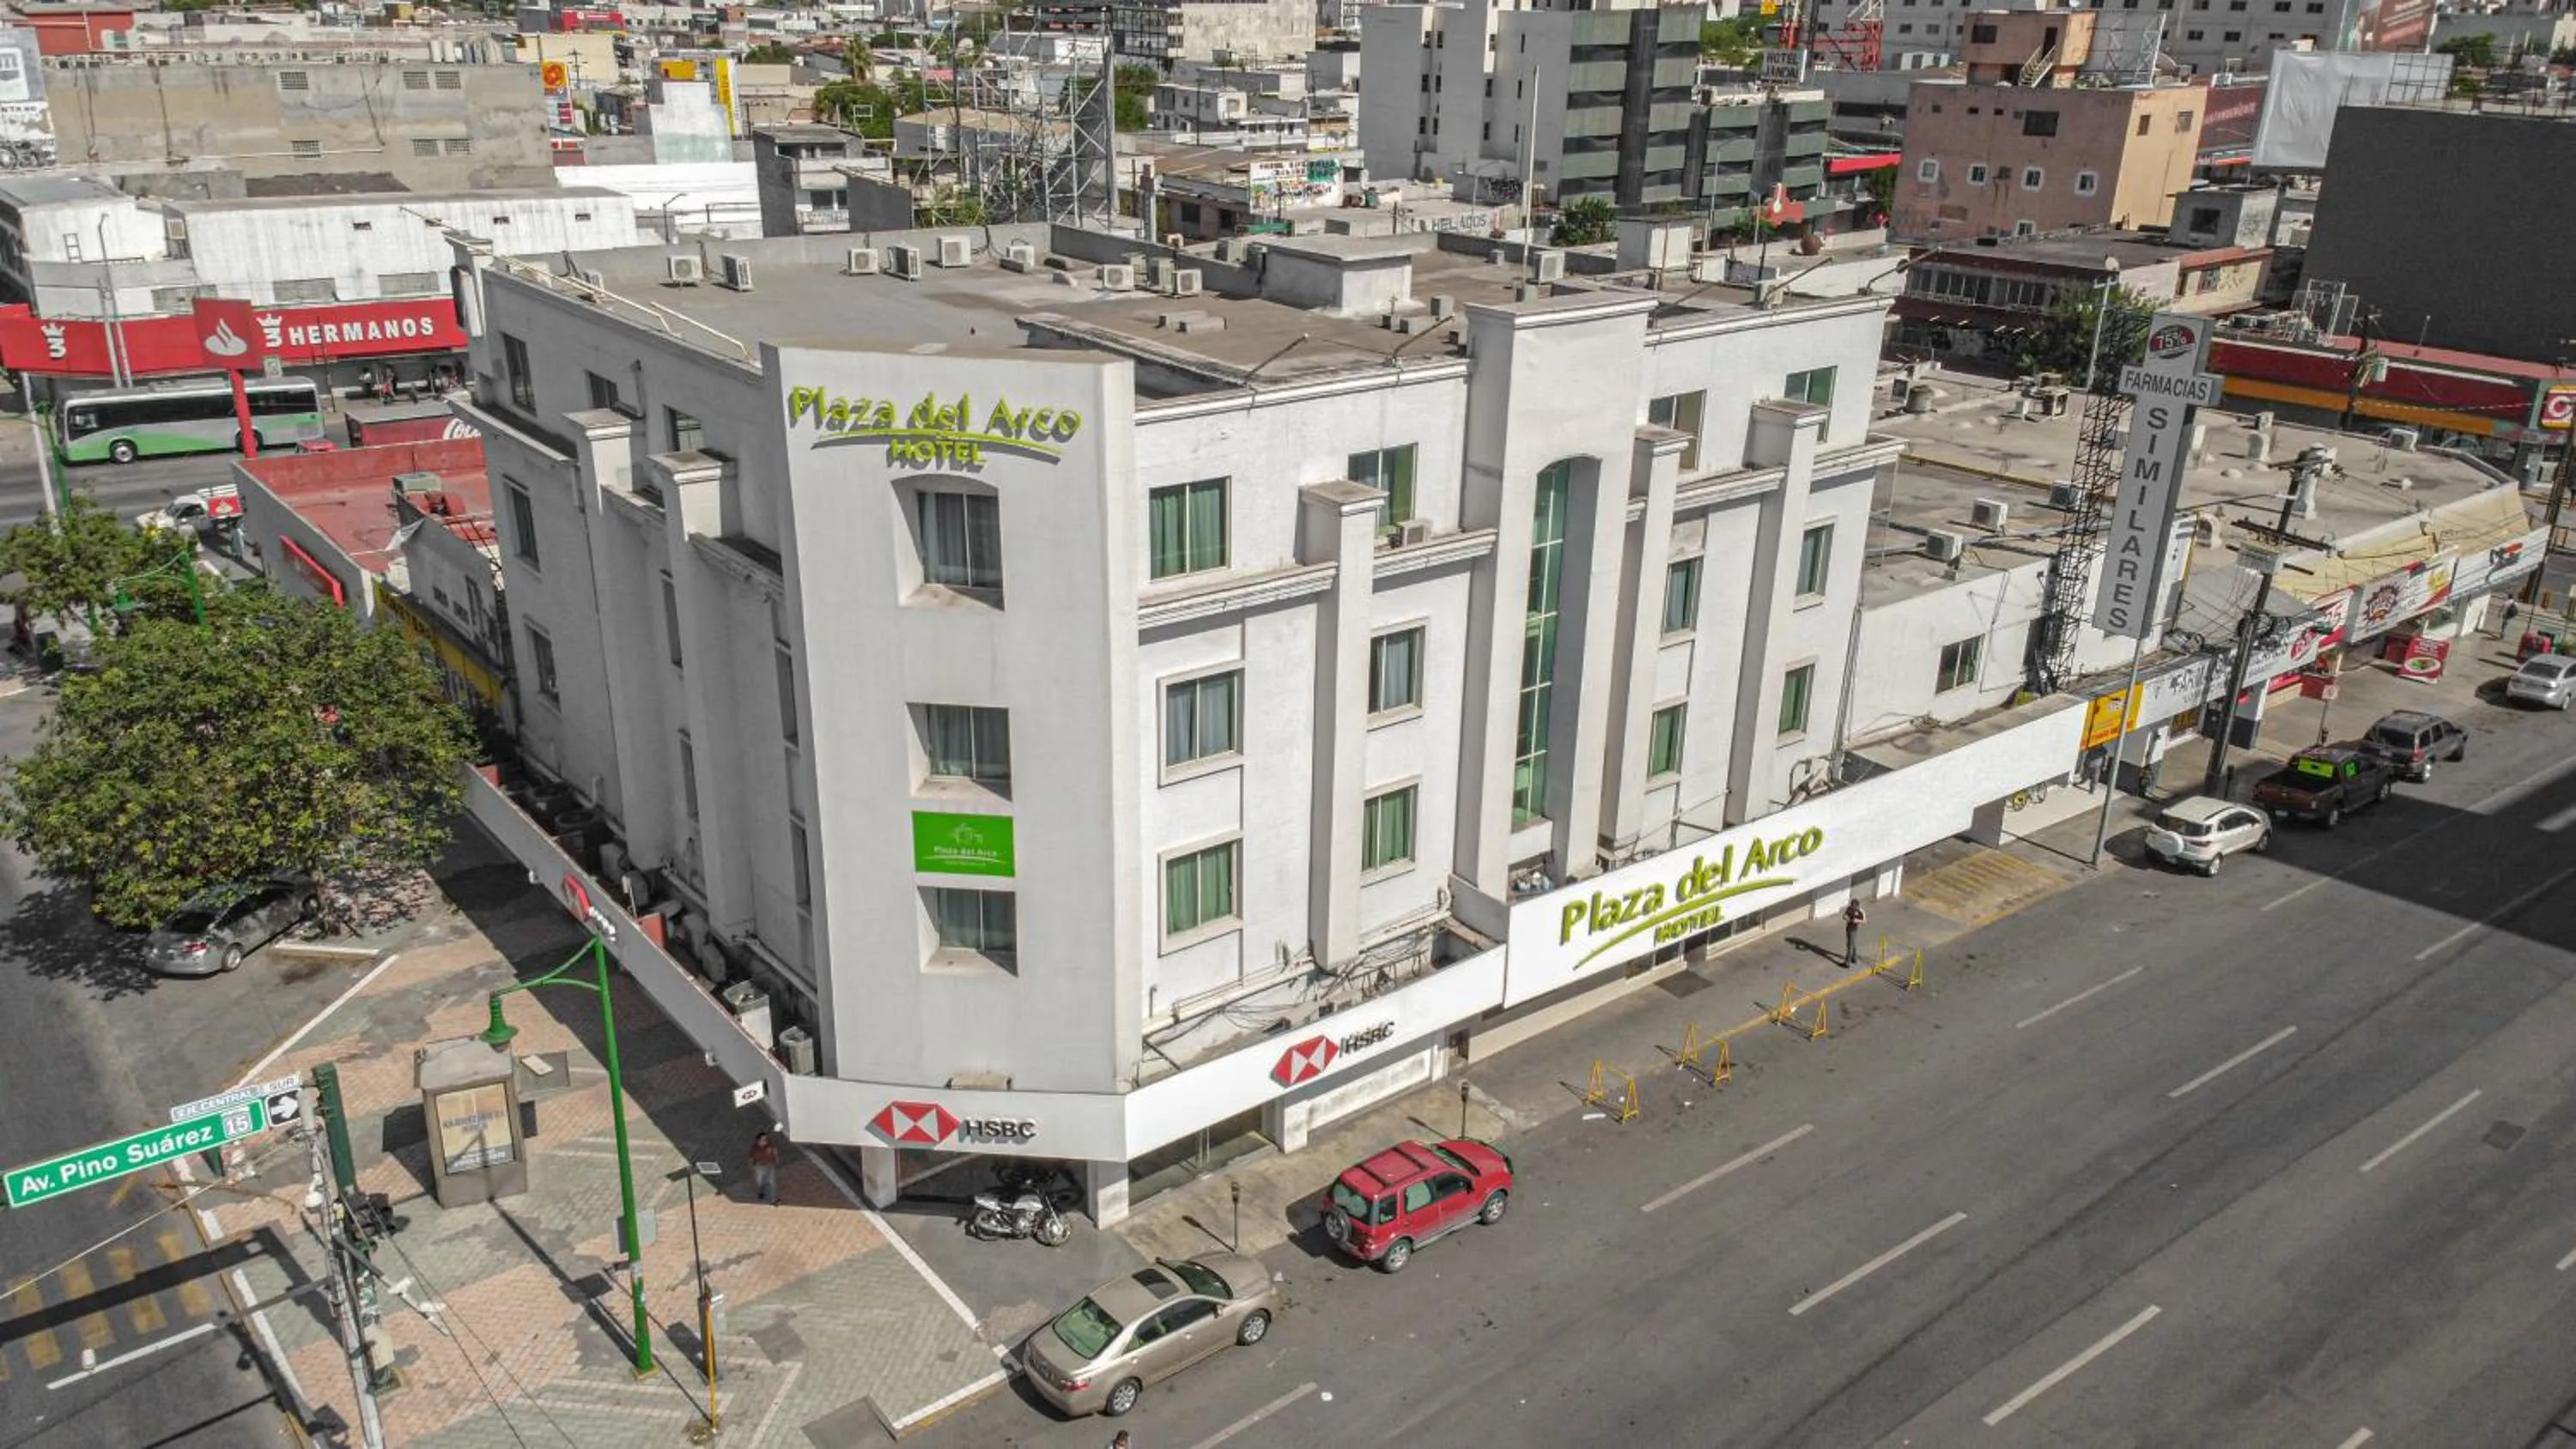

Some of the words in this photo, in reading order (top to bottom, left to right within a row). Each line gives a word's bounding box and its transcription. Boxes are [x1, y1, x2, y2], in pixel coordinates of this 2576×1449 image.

[289, 316, 434, 347] HERMANOS
[2124, 370, 2208, 400] FARMACIAS
[793, 386, 896, 425] Plaza
[913, 391, 971, 429] del
[989, 398, 1083, 436] Arco
[890, 437, 987, 464] HOTEL
[2108, 407, 2169, 629] SIMILARES
[1560, 882, 1665, 946] Plaza
[1677, 844, 1734, 901] del
[1739, 826, 1824, 882] Arco
[1655, 906, 1723, 945] HOTEL
[1345, 1021, 1395, 1054] HSBC
[200, 1089, 253, 1112] CENTRAL
[269, 1077, 295, 1091] SUR
[963, 1119, 1036, 1139] HSBC
[21, 1175, 55, 1197] Av.
[59, 1153, 118, 1184] Pino
[125, 1125, 214, 1164] Suárez
[224, 1116, 250, 1137] 15
